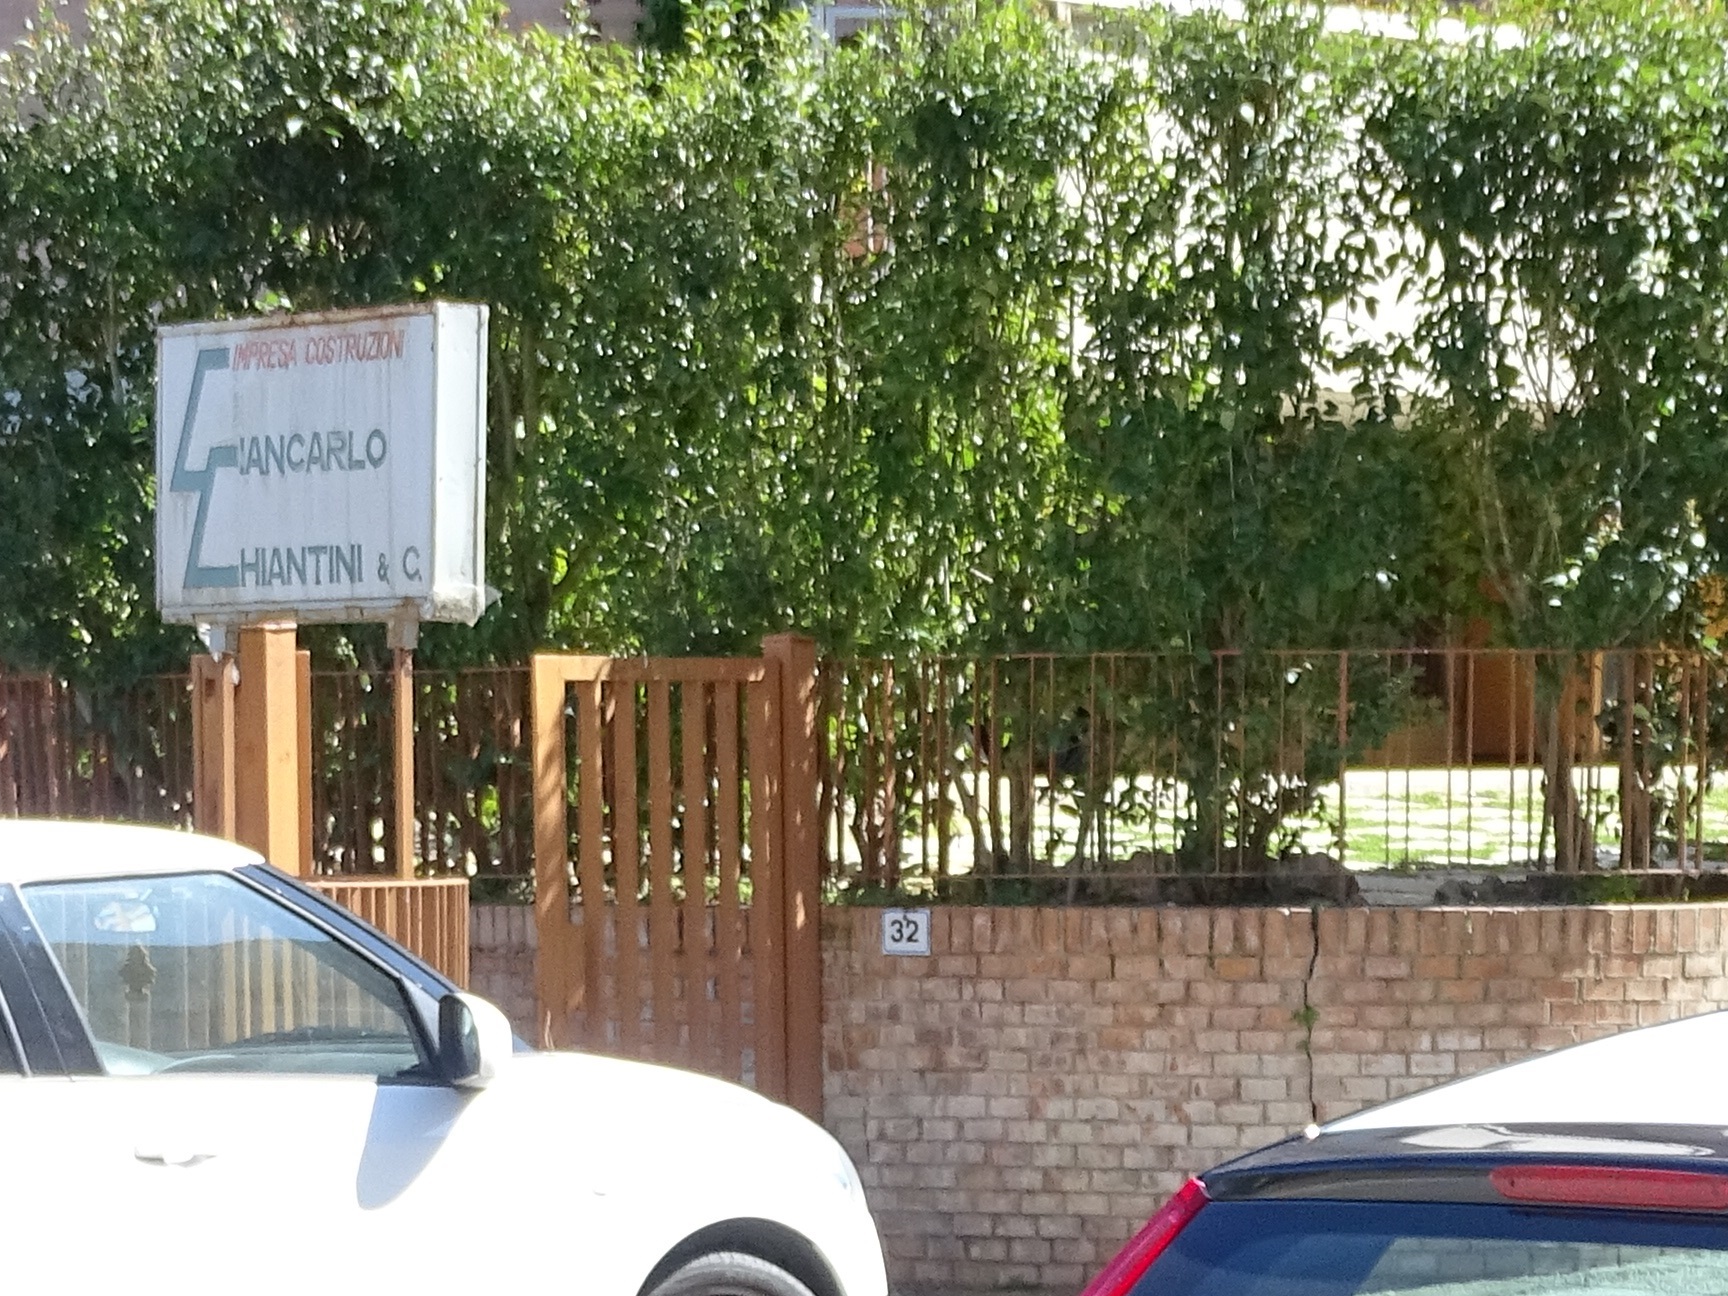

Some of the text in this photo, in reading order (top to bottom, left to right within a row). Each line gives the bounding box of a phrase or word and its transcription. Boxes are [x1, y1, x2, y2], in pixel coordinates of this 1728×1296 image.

[233, 330, 404, 371] IMPRESA COSTRUZIONI
[891, 918, 919, 943] 32
